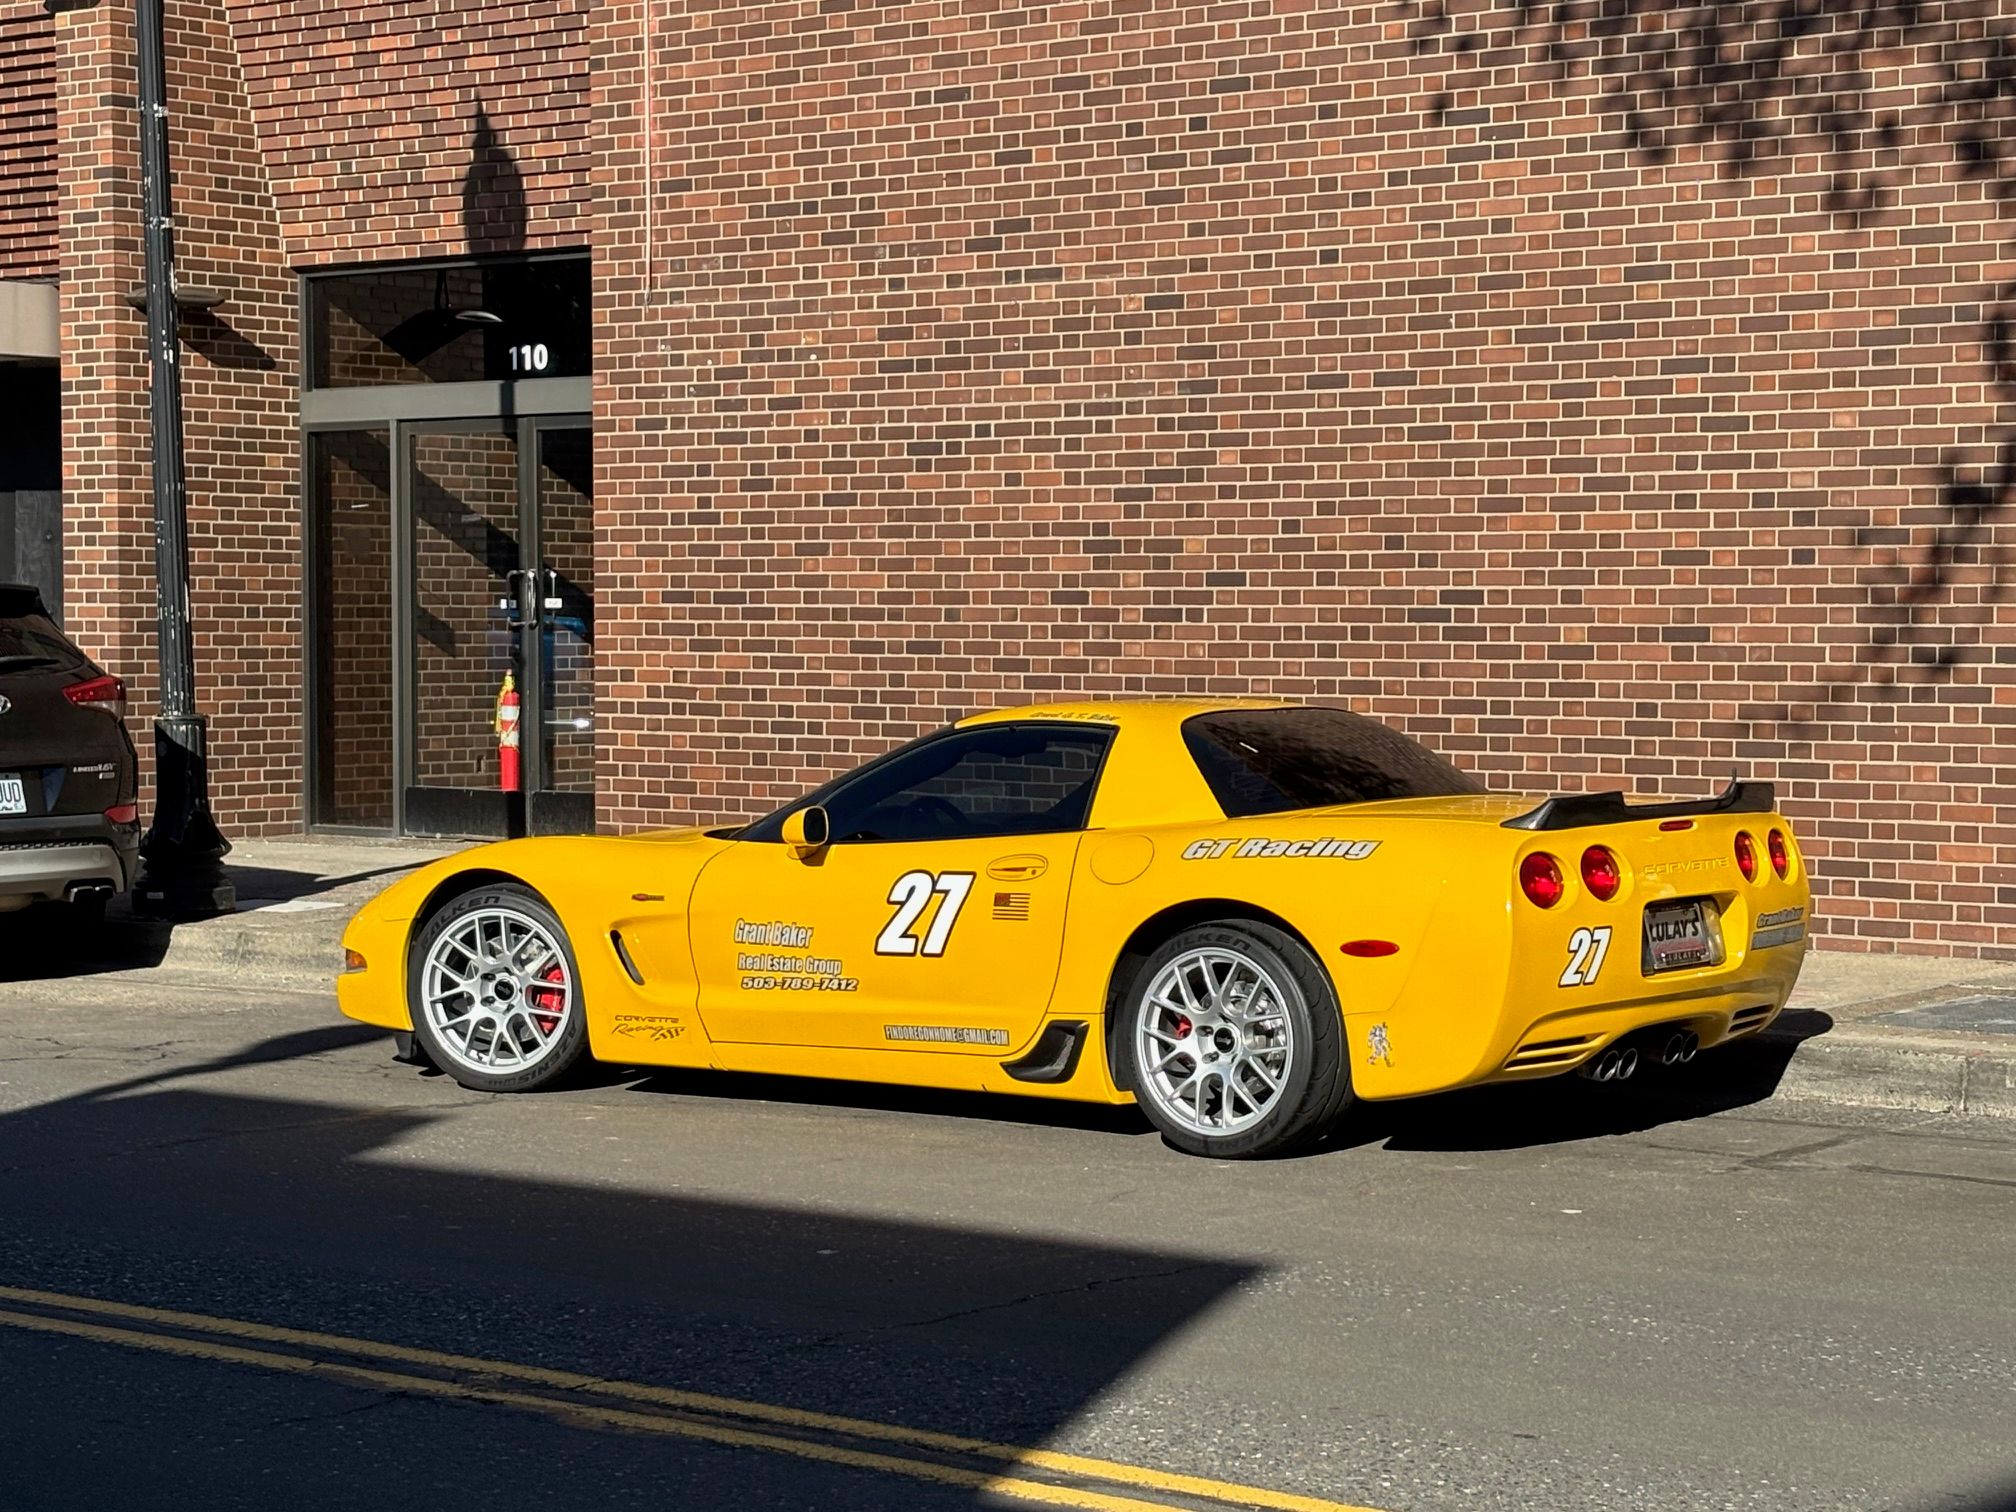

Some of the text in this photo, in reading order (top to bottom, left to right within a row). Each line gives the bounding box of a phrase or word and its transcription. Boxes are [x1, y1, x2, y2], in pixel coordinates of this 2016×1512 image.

[508, 343, 549, 371] 110
[1181, 837, 1383, 861] GT Racing
[873, 869, 977, 958] 27
[734, 917, 814, 948] Grant Baker
[738, 953, 842, 977] Real Estate Group
[1557, 926, 1613, 988] 27
[741, 976, 859, 992] 503-789-7412
[614, 1014, 680, 1024] CORVETTE
[883, 1024, 1010, 1047] FINDOREGONHOME@GMAIL.COM
